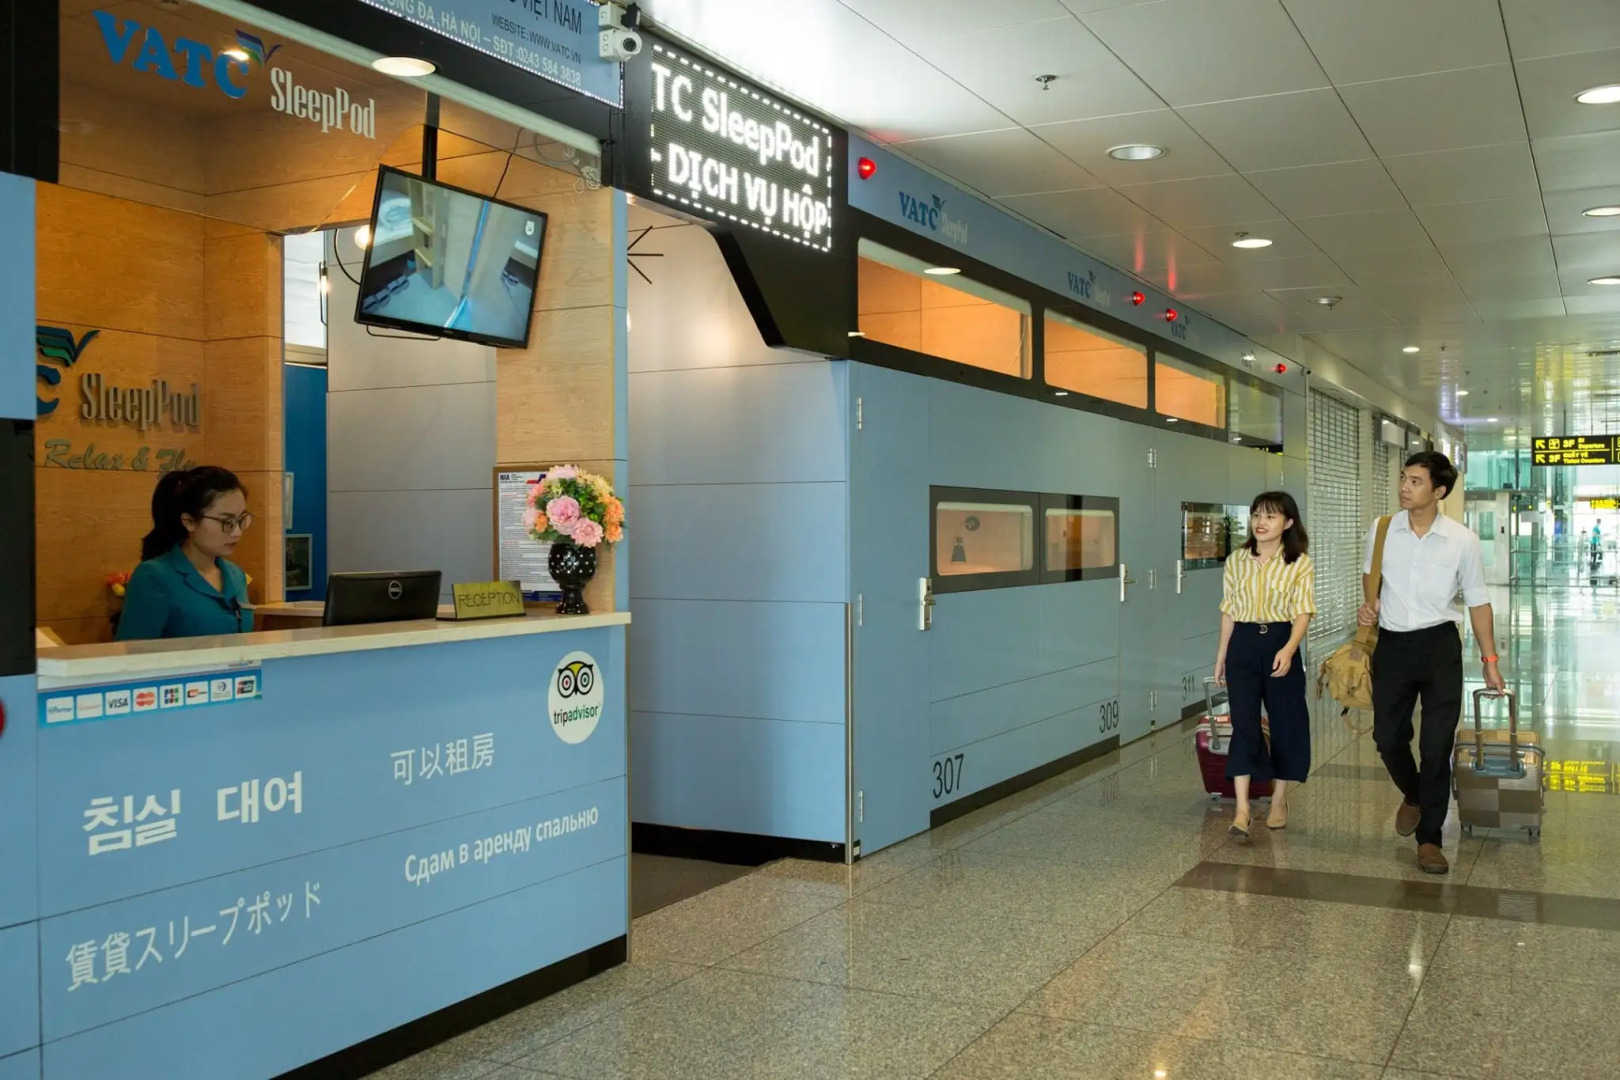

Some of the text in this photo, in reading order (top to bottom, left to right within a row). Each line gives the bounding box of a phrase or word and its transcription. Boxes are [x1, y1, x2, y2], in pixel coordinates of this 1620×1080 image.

[553, 0, 582, 35] NAM
[93, 9, 376, 140] VATC SleepPod
[541, 57, 559, 77] 584
[560, 65, 581, 86] 3838
[701, 87, 819, 177] SleepPod
[668, 143, 738, 205] DỊCH
[744, 172, 778, 225] VỤ
[783, 183, 828, 239] HỘP
[899, 191, 939, 231] VATC
[1067, 271, 1091, 299] VATC
[82, 373, 200, 431] SleepPod
[44, 439, 124, 470] Relax
[1548, 454, 1560, 463] 3F
[458, 591, 520, 608] RECEPTION
[108, 698, 128, 709] VISA
[1181, 674, 1195, 701] 311
[553, 704, 599, 727] tripadvisor
[1099, 700, 1119, 734] 309
[390, 732, 495, 786] 可以租房
[932, 753, 965, 799] 307
[82, 770, 303, 856] 침실 대여
[404, 806, 599, 886] Сдам в аренду спальню
[65, 880, 321, 992] 賃貸スリープポッド
